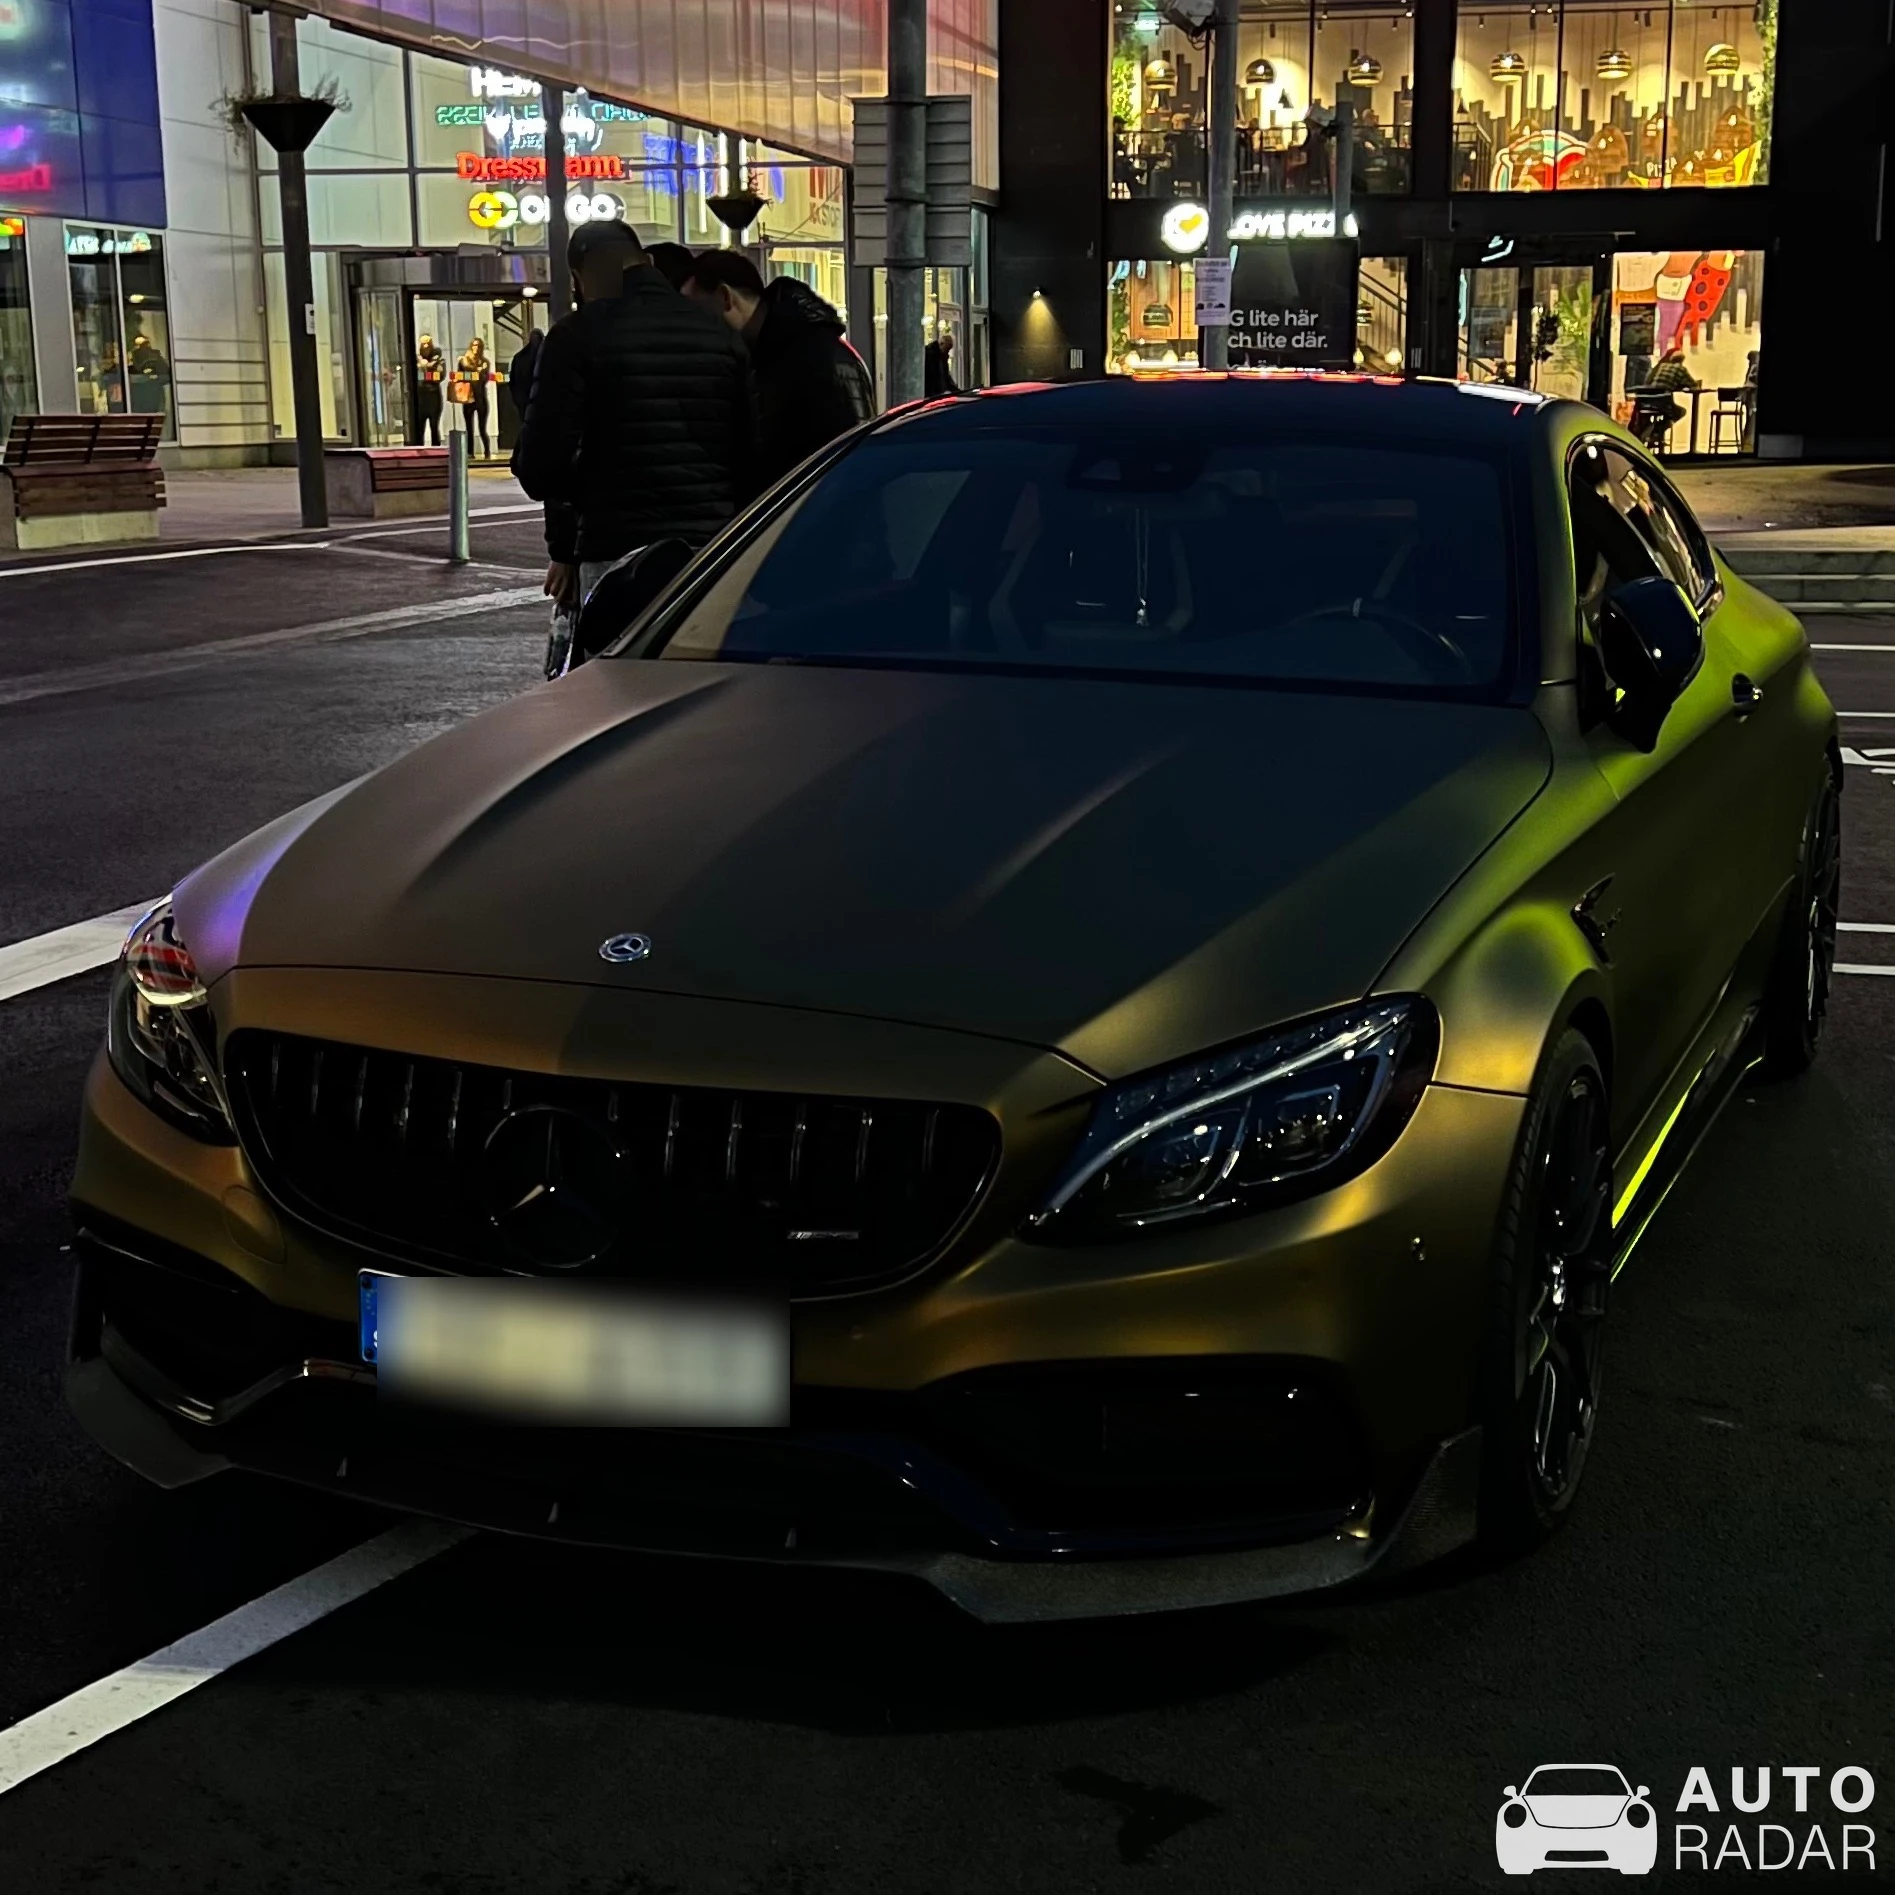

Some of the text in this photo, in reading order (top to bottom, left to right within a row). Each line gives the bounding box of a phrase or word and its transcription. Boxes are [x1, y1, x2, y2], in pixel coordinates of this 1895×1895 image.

[457, 151, 623, 179] Dressann
[1250, 310, 1280, 326] lite
[1285, 310, 1319, 326] här
[1228, 331, 1328, 348] ch lite där.
